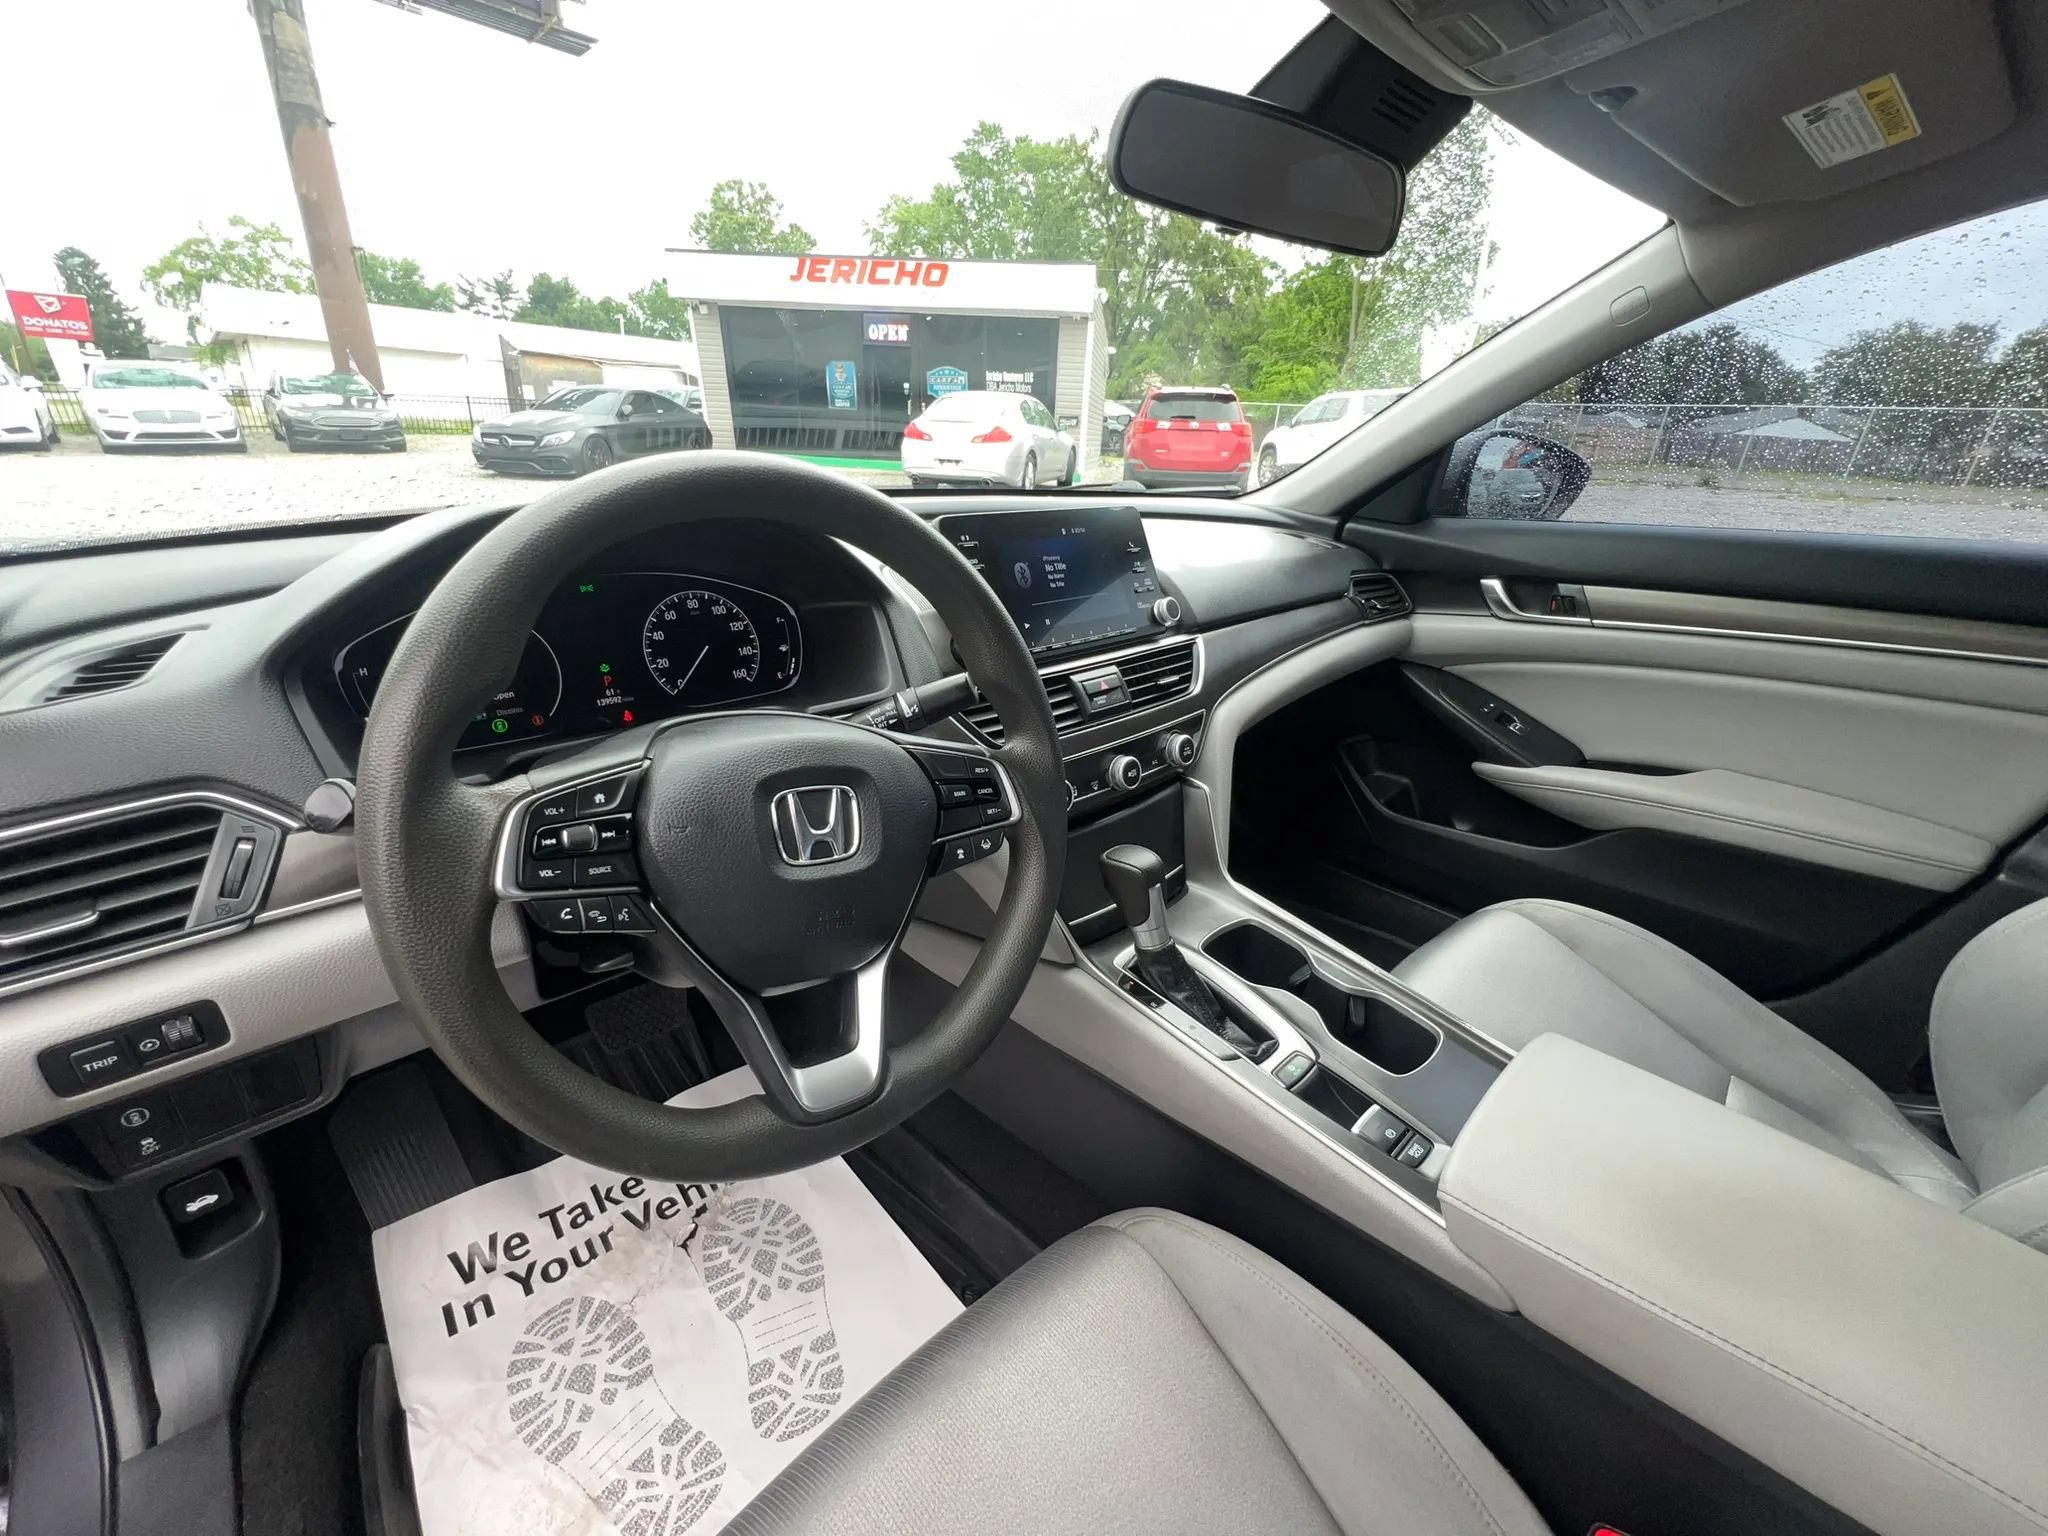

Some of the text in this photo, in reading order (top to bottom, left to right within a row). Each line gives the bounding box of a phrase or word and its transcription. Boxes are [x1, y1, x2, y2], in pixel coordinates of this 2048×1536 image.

[789, 257, 949, 287] JERICHO
[21, 315, 89, 330] DONATOS
[868, 324, 909, 341] OPEN
[686, 599, 698, 608] 80
[664, 610, 676, 620] 60
[711, 606, 726, 615] 100
[729, 621, 744, 631] 120
[652, 630, 664, 641] 40
[738, 645, 752, 656] 140
[656, 658, 669, 668] 20
[359, 667, 368, 677] H
[732, 668, 747, 679] 160
[604, 675, 612, 687] P
[605, 688, 615, 696] 61
[596, 696, 622, 706] 139592
[588, 865, 613, 875] SOURCE
[82, 1055, 118, 1072] TRIP
[447, 1176, 646, 1284] We Take
[441, 1182, 736, 1338] In Your Veh
